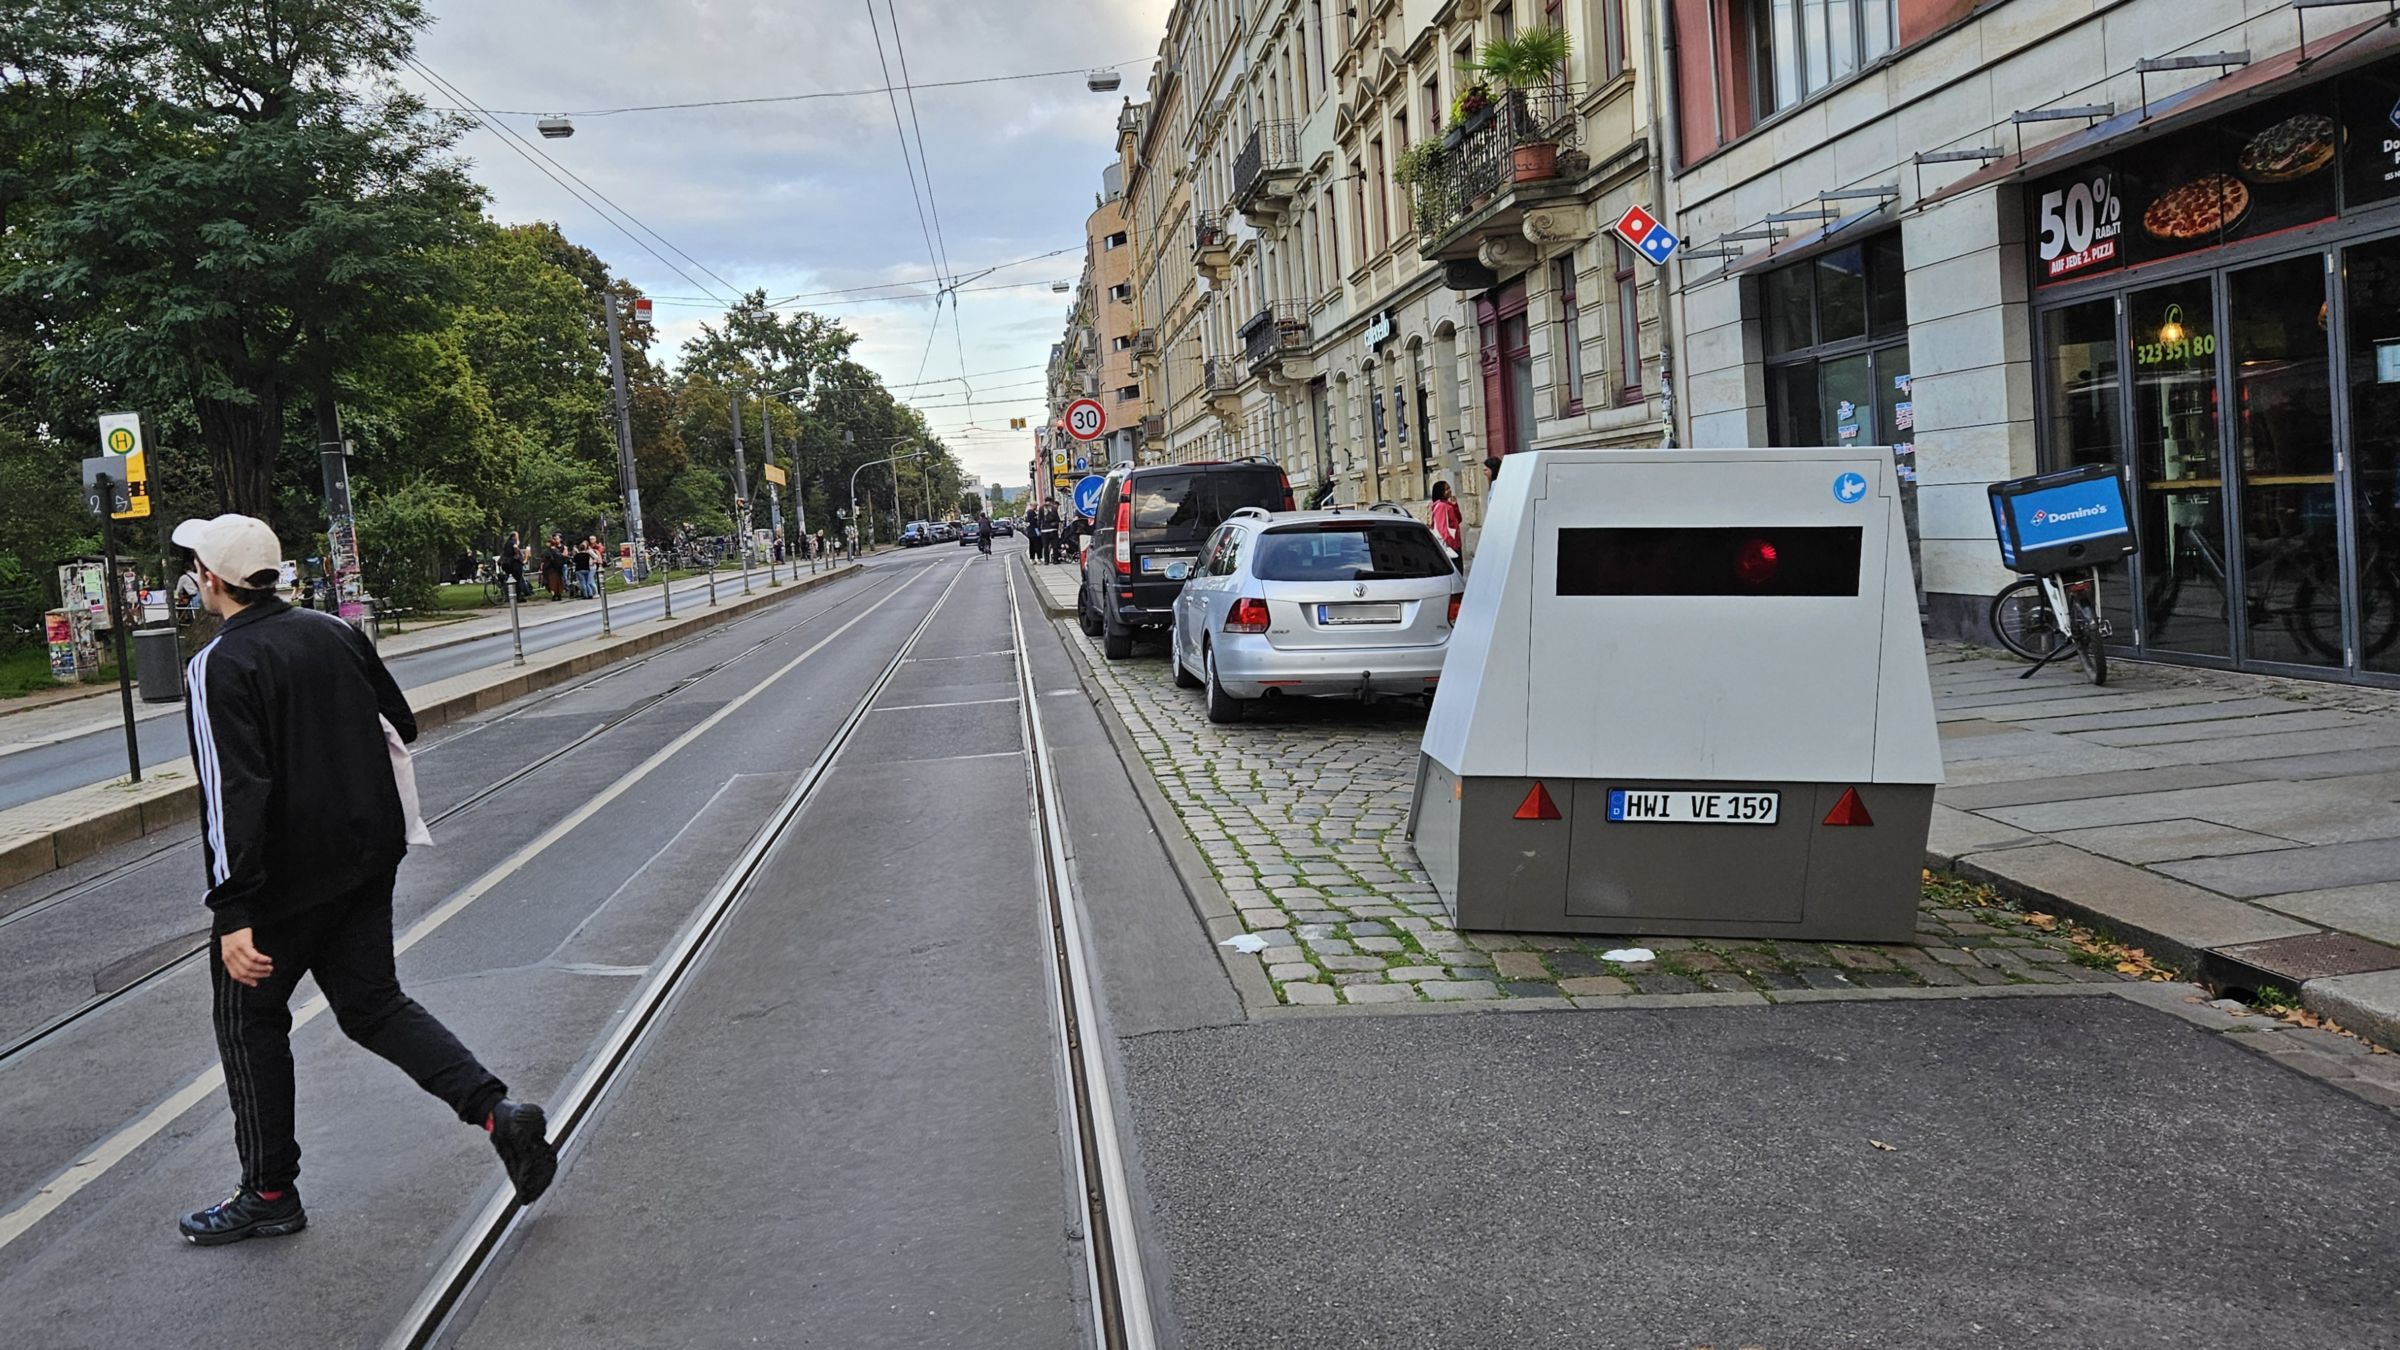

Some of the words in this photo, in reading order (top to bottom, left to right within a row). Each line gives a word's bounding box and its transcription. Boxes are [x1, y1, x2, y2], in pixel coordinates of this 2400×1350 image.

[2040, 173, 2120, 260] 50%
[2051, 258, 2064, 274] AUF
[2065, 252, 2082, 269] JEDE
[2082, 250, 2091, 264] 2.
[2092, 241, 2114, 260] PIZZA
[2138, 342, 2162, 364] 323
[2193, 334, 2215, 357] 80
[1073, 410, 1097, 430] 30
[115, 432, 128, 449] H
[2048, 504, 2107, 524] Domino's
[1627, 795, 1670, 817] HWI
[1691, 795, 1721, 818] VE
[1727, 796, 1773, 820] 159
